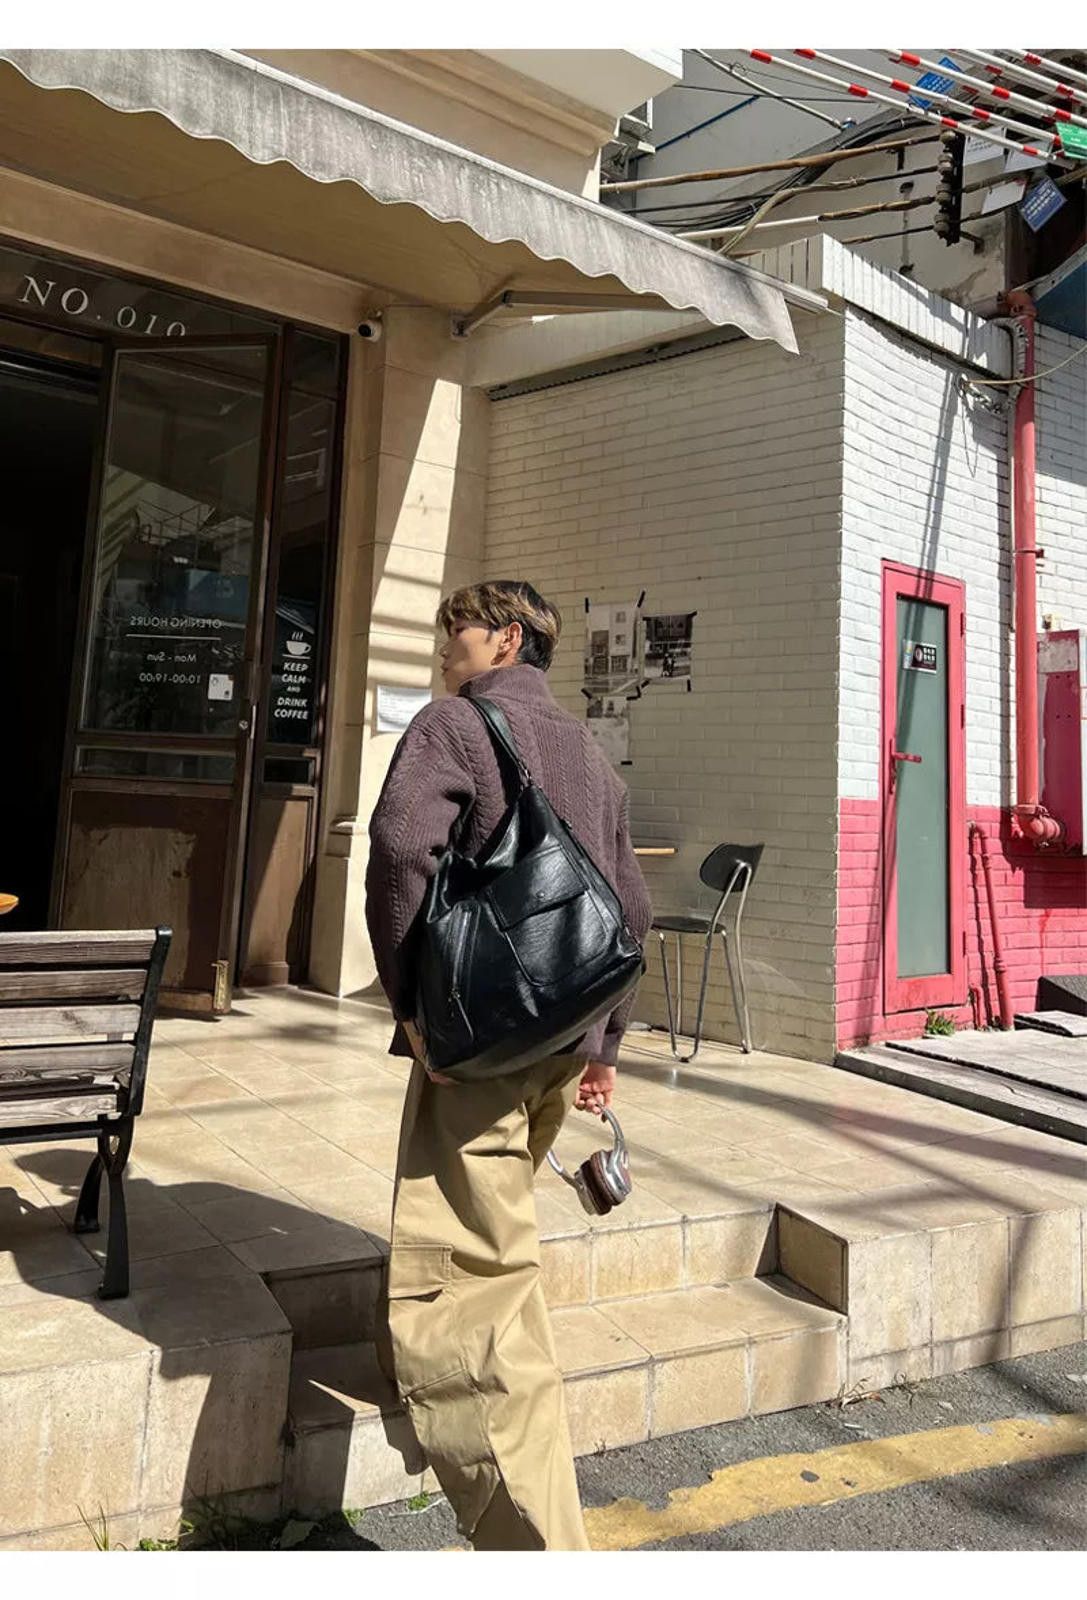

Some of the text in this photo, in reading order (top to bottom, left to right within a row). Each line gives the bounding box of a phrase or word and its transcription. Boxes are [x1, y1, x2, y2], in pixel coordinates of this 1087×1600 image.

[283, 662, 309, 672] KEEP
[281, 673, 307, 684] CALM
[277, 696, 308, 707] DRINK
[274, 708, 309, 720] COFFEE
